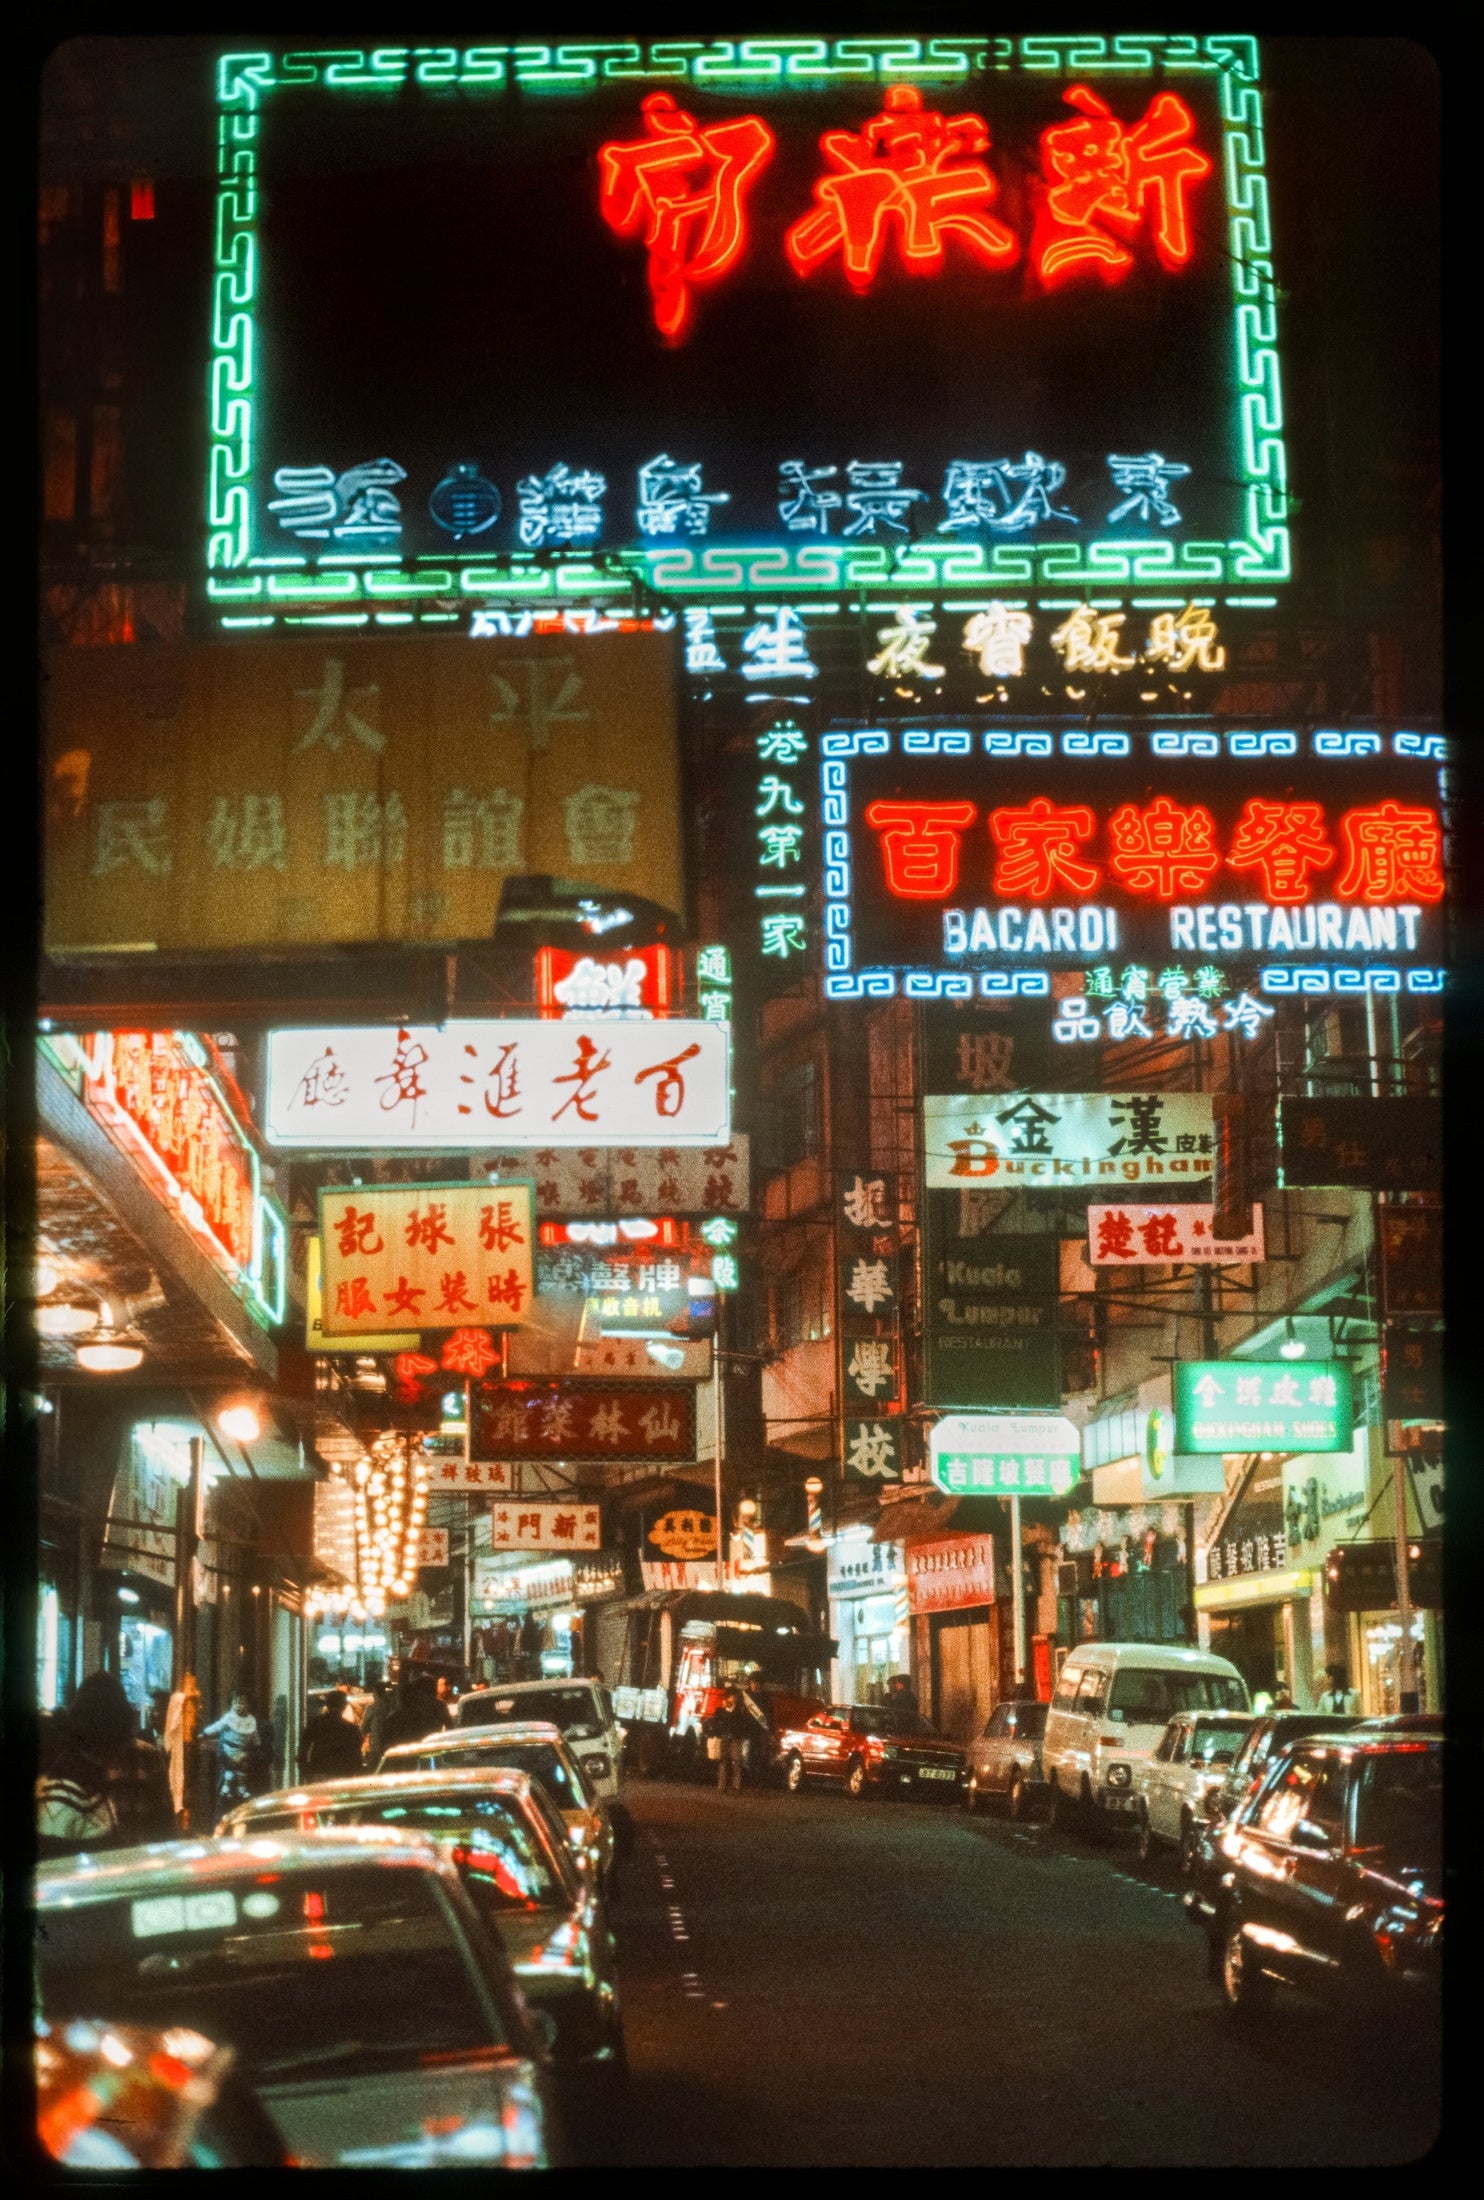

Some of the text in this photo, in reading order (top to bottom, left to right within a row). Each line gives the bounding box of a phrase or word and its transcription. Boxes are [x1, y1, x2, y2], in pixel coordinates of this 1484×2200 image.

[753, 720, 808, 958] 港九第一家
[864, 797, 1448, 902] 百家樂餐廳
[942, 904, 1423, 954] BACARDI RESTAURANT
[1053, 993, 1275, 1042] 冷熱飲品
[995, 1095, 1167, 1156] 金漢
[946, 1138, 1213, 1182] Buckingham
[333, 1200, 526, 1258] 張球記
[333, 1268, 528, 1320] 時裝女服
